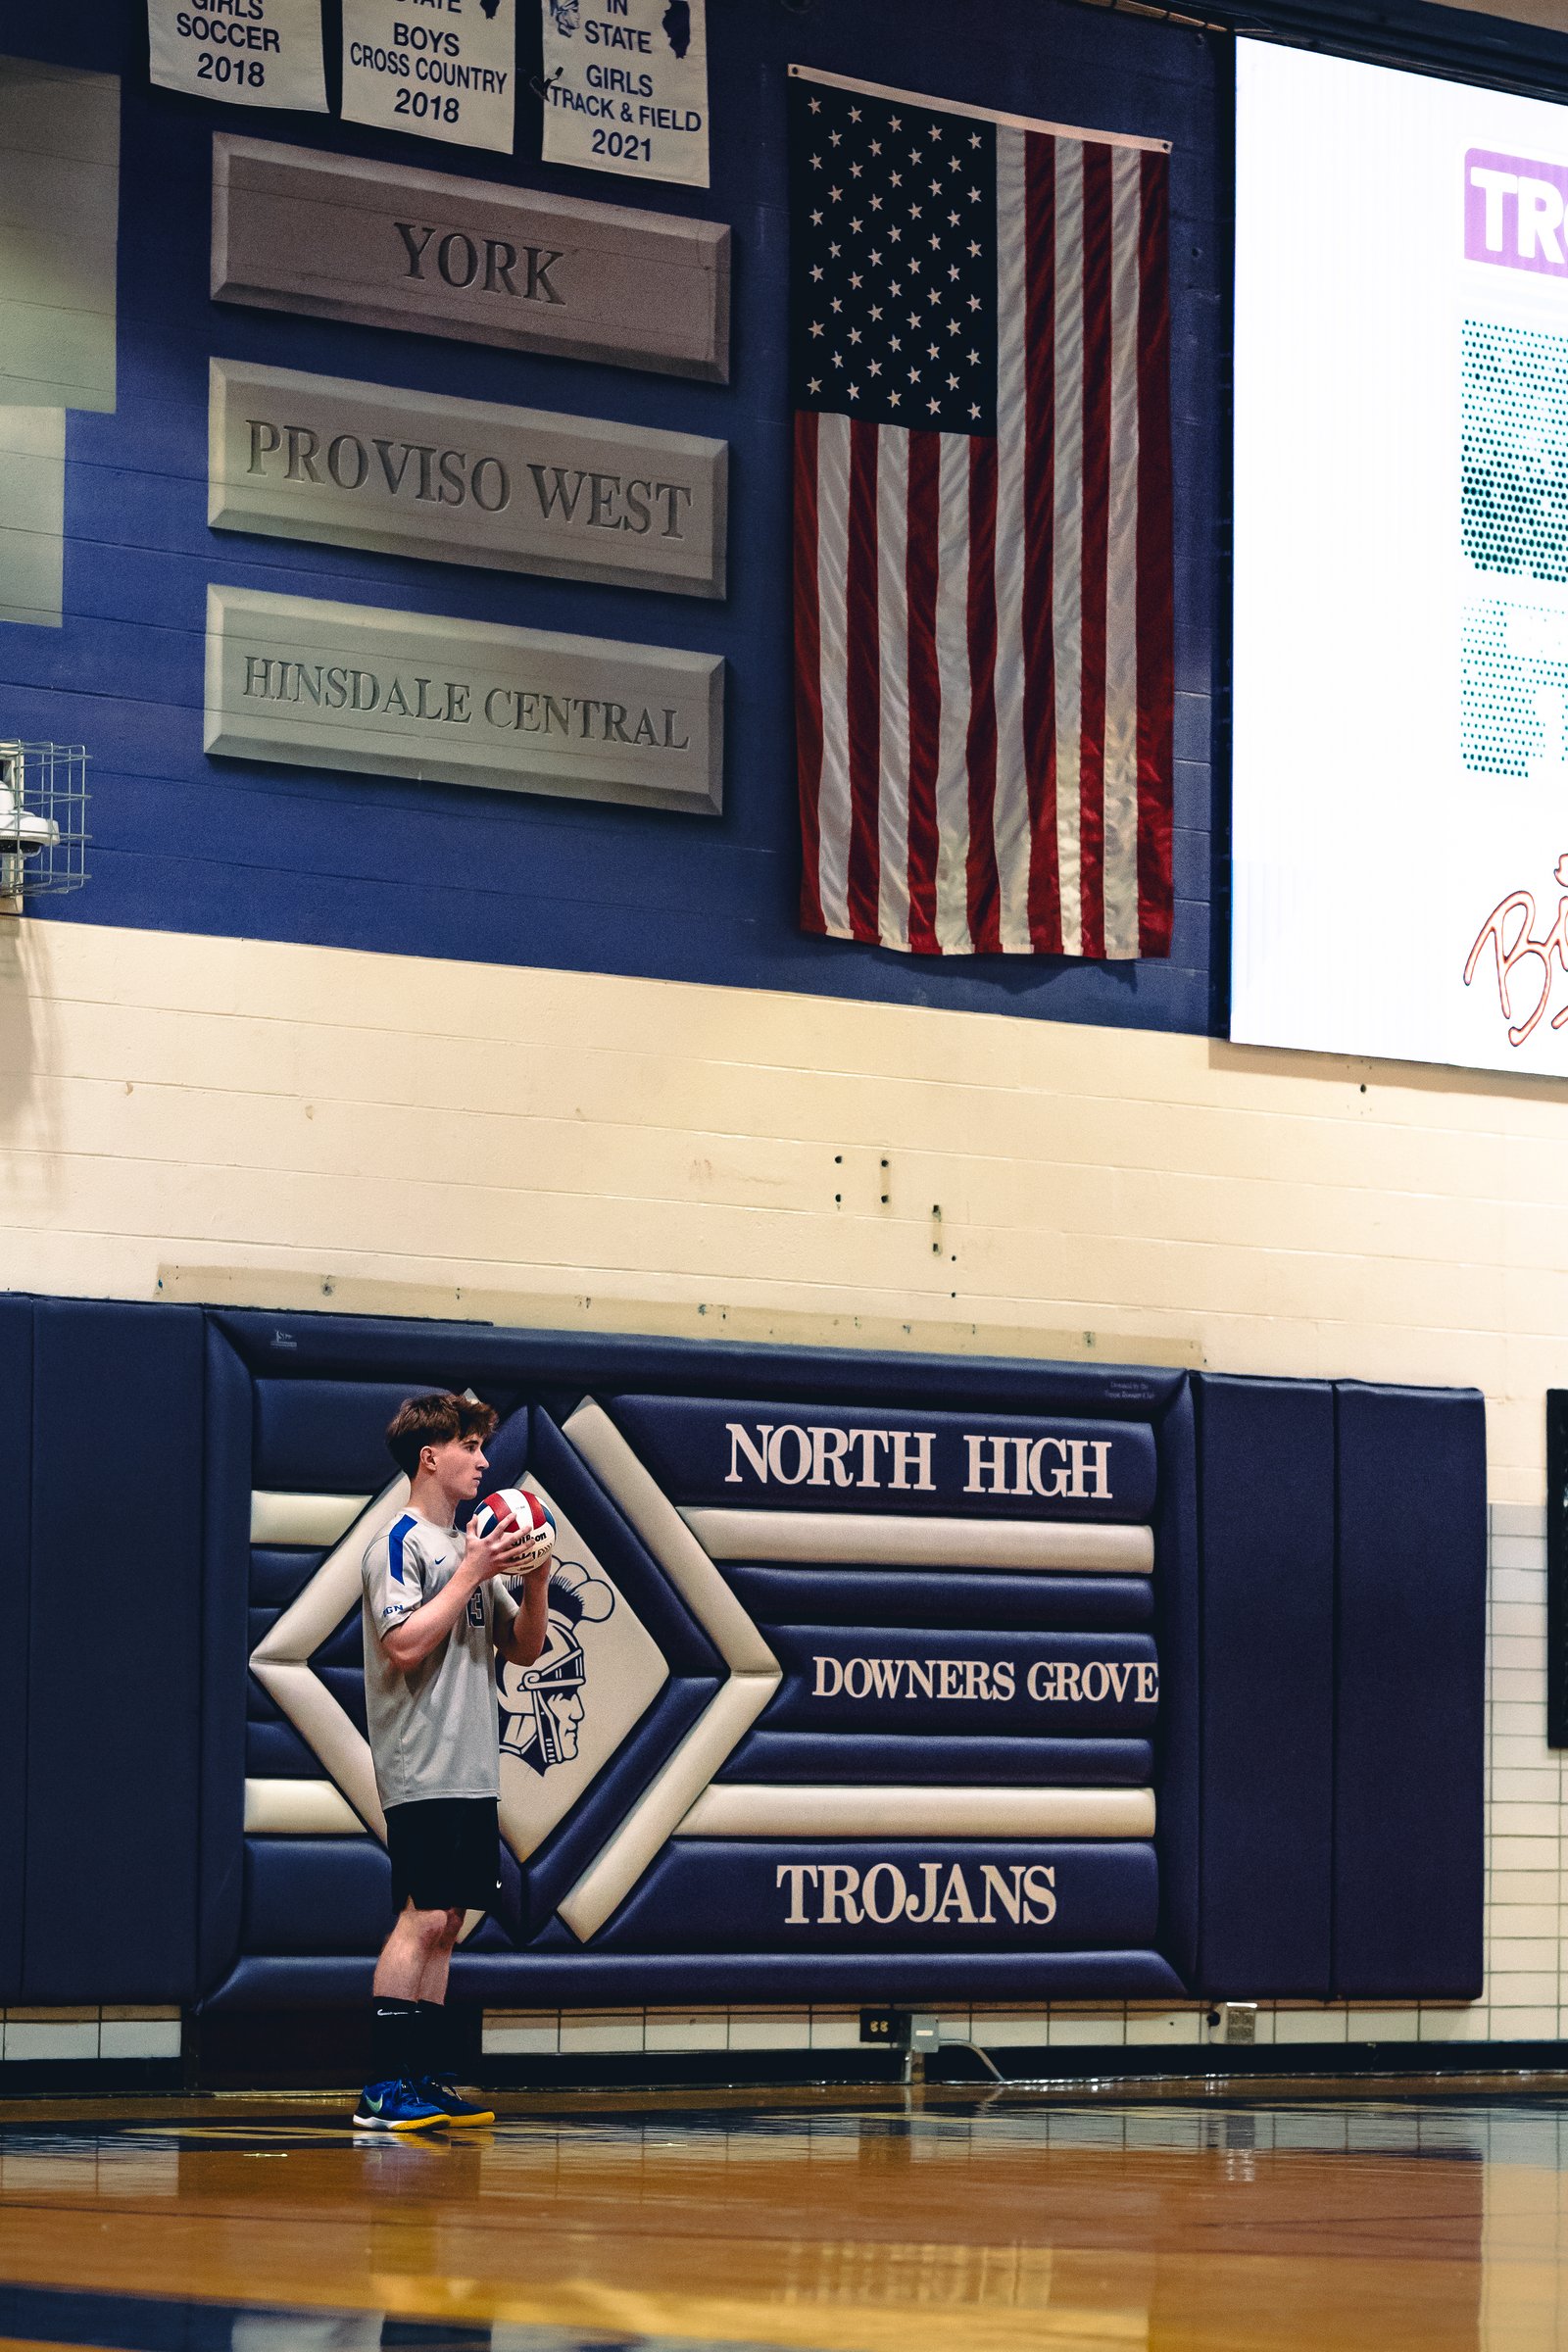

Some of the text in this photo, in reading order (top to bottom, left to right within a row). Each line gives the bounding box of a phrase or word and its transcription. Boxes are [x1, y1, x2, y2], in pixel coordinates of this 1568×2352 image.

[176, 12, 280, 53] SOCCER
[394, 23, 460, 57] BOYS
[585, 20, 653, 54] STATE
[197, 52, 265, 87] 2018
[350, 42, 508, 94] CROSS COUNTRY
[586, 64, 653, 97] GIRLS
[394, 88, 460, 123] 2018
[551, 85, 702, 132] TRACK & FIELD
[592, 128, 651, 162] 2021
[1471, 166, 1568, 266] TR
[395, 222, 566, 306] YORK
[244, 418, 693, 541] PROVISO WEST
[242, 656, 690, 752] HINSDALE CENTRAL
[724, 1423, 1113, 1499] NORTH HIGH
[811, 1656, 1159, 1703] DOWNERS GROVE
[776, 1862, 1057, 1925] TROJANS
